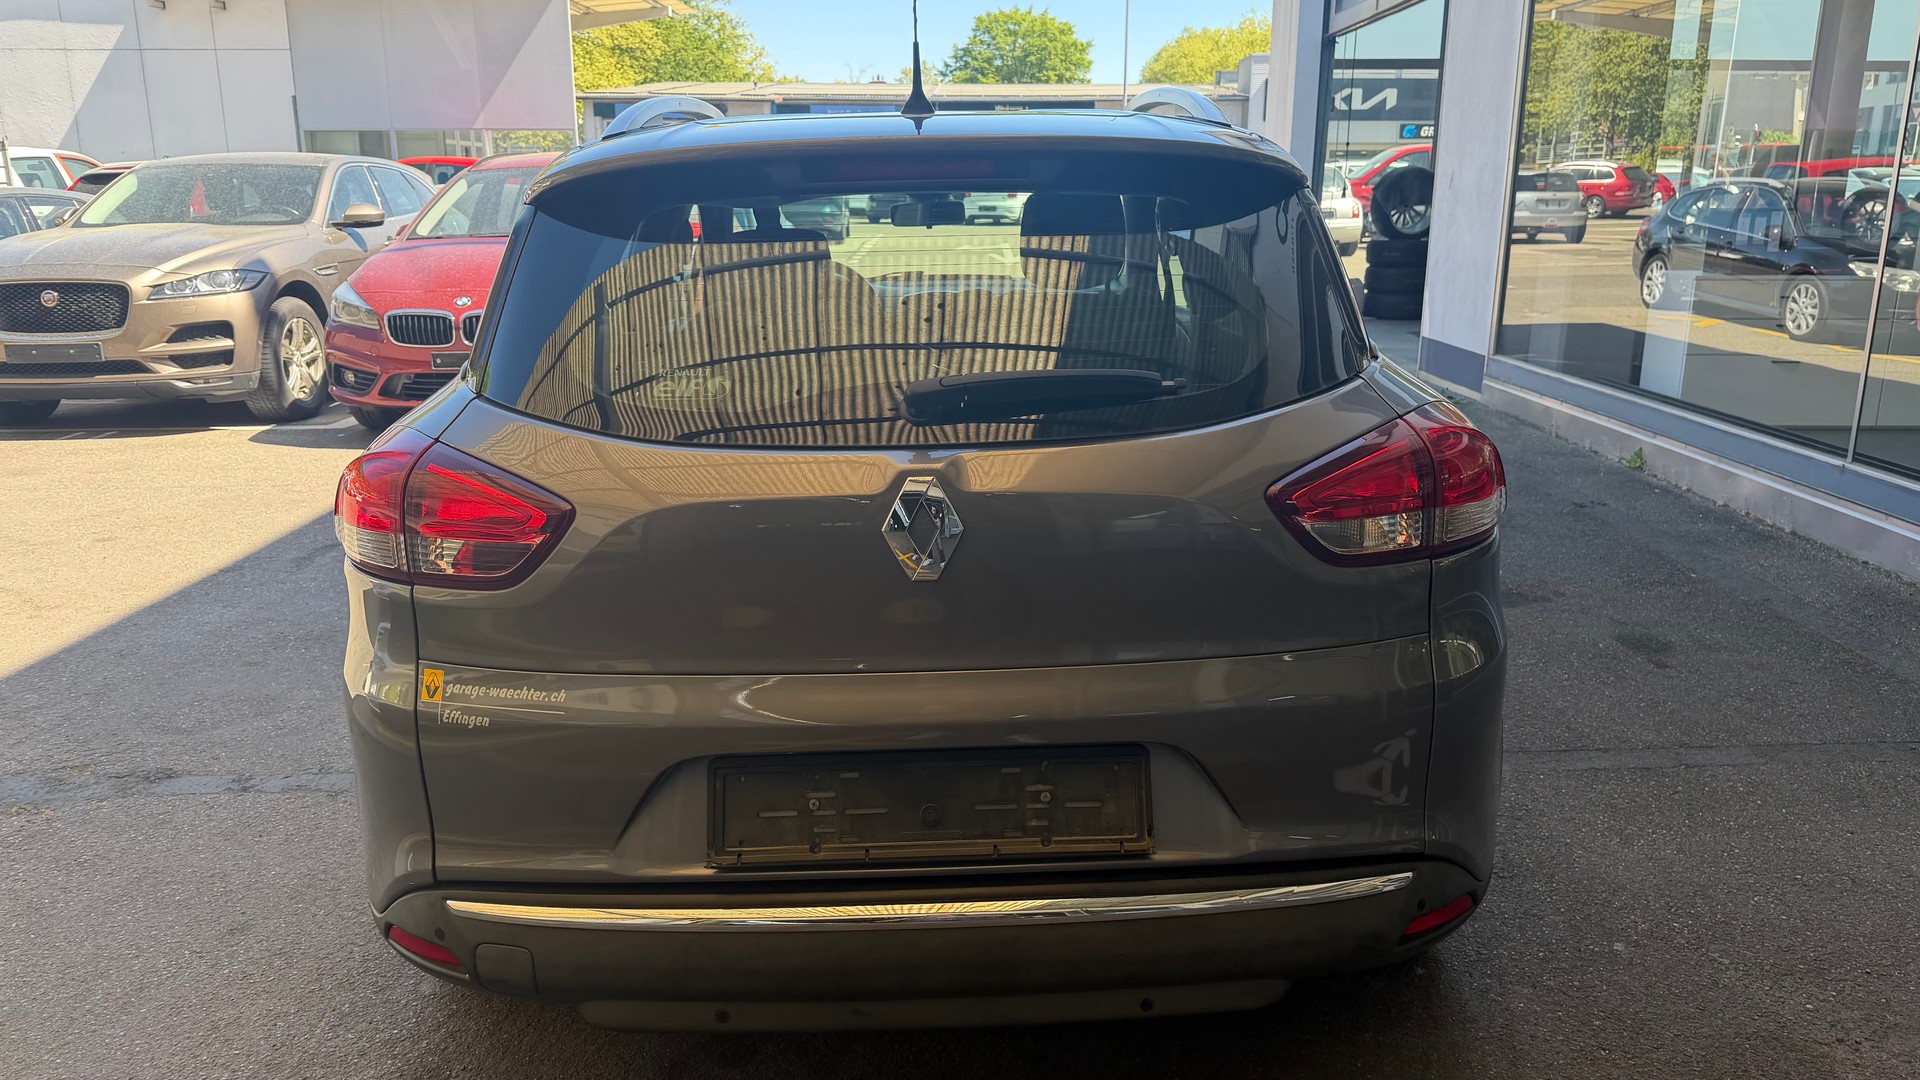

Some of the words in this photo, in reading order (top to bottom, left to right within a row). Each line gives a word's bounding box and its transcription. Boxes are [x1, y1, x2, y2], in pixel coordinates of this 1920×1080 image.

[1334, 88, 1398, 111] KIA
[659, 368, 712, 377] RENAULT
[445, 683, 567, 703] garage-waechter.ch
[442, 709, 490, 729] Effingen
